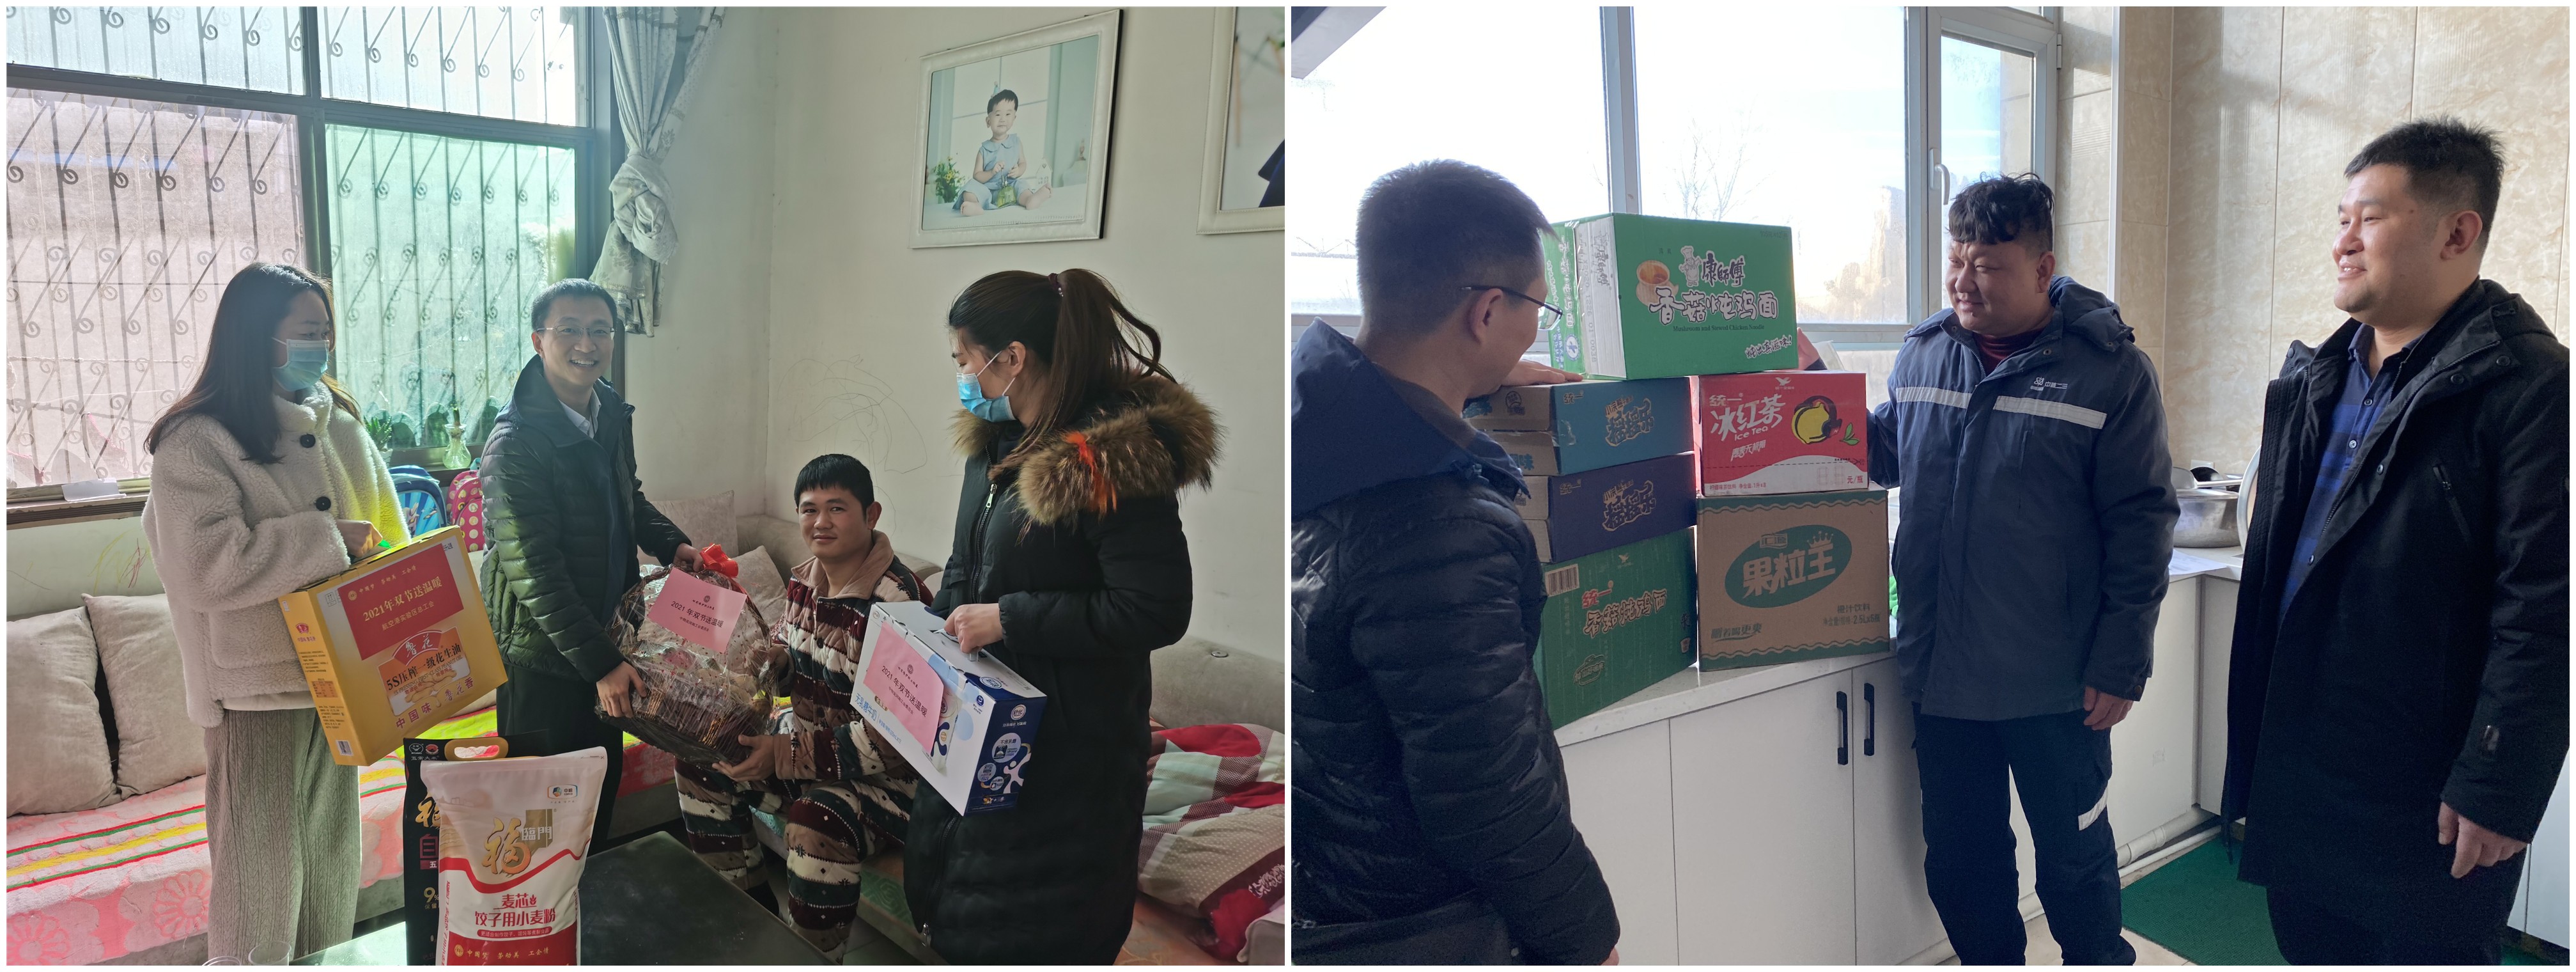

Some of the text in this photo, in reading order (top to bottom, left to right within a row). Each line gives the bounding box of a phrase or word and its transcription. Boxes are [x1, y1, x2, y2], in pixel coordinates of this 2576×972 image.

[1649, 286, 1779, 325] 香菇炖鸡面
[1563, 391, 1583, 404] 统一
[1709, 394, 1742, 407] 统一
[1711, 393, 1786, 441] 冰红茶
[1735, 425, 1769, 441] Ice Tea
[1560, 480, 1581, 495] 统一
[1743, 543, 1836, 599] 果粒王
[362, 576, 442, 622] 2021年双节送温暖
[1582, 588, 1612, 608] 统一
[382, 600, 435, 631] 航空港实验区总工会
[671, 600, 685, 612] 2021
[687, 608, 724, 629] 年双节送温暖
[1583, 588, 1667, 638] 香菇炖鸡面
[386, 643, 462, 691] 5S压榨一级花生油
[881, 665, 893, 681] 2021
[894, 677, 928, 717] 年双节送温暖
[396, 702, 432, 729] 中国味
[420, 833, 439, 859] 自
[430, 861, 437, 869] 五
[501, 893, 529, 909] 麦芯
[475, 908, 555, 928] 饺子用小麦粉
[467, 946, 549, 959] 中国梦 劳动美 工会情
